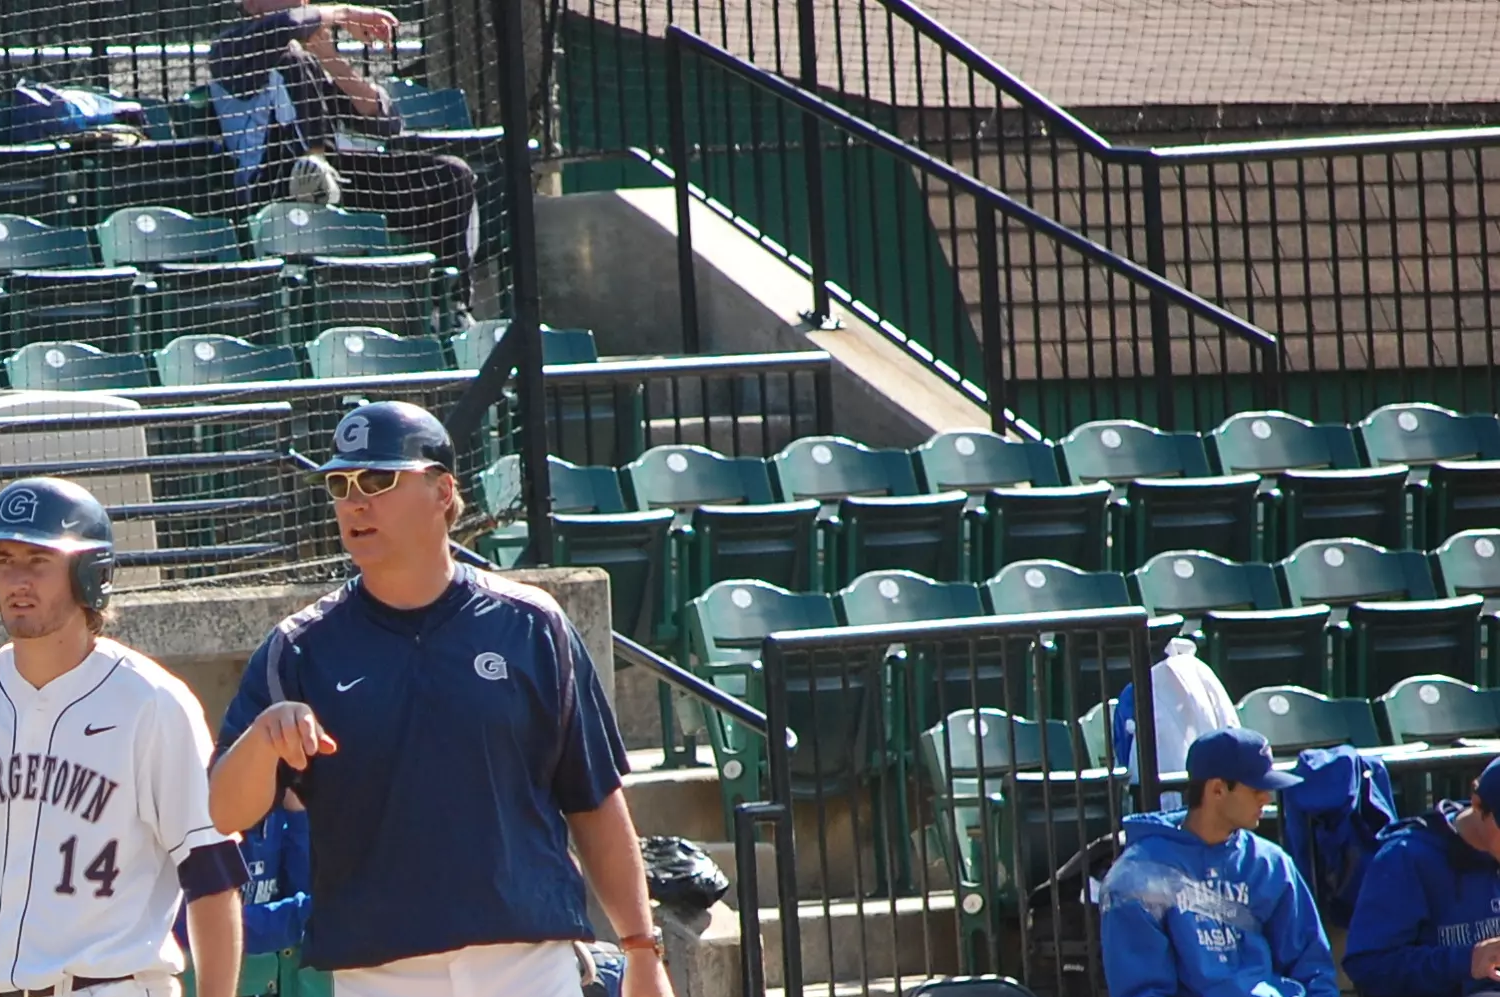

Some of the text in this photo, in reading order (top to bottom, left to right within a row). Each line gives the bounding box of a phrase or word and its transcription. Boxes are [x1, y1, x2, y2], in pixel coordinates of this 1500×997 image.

[333, 415, 370, 452] G
[0, 488, 39, 523] G
[473, 651, 509, 680] G
[54, 834, 120, 898] 14
